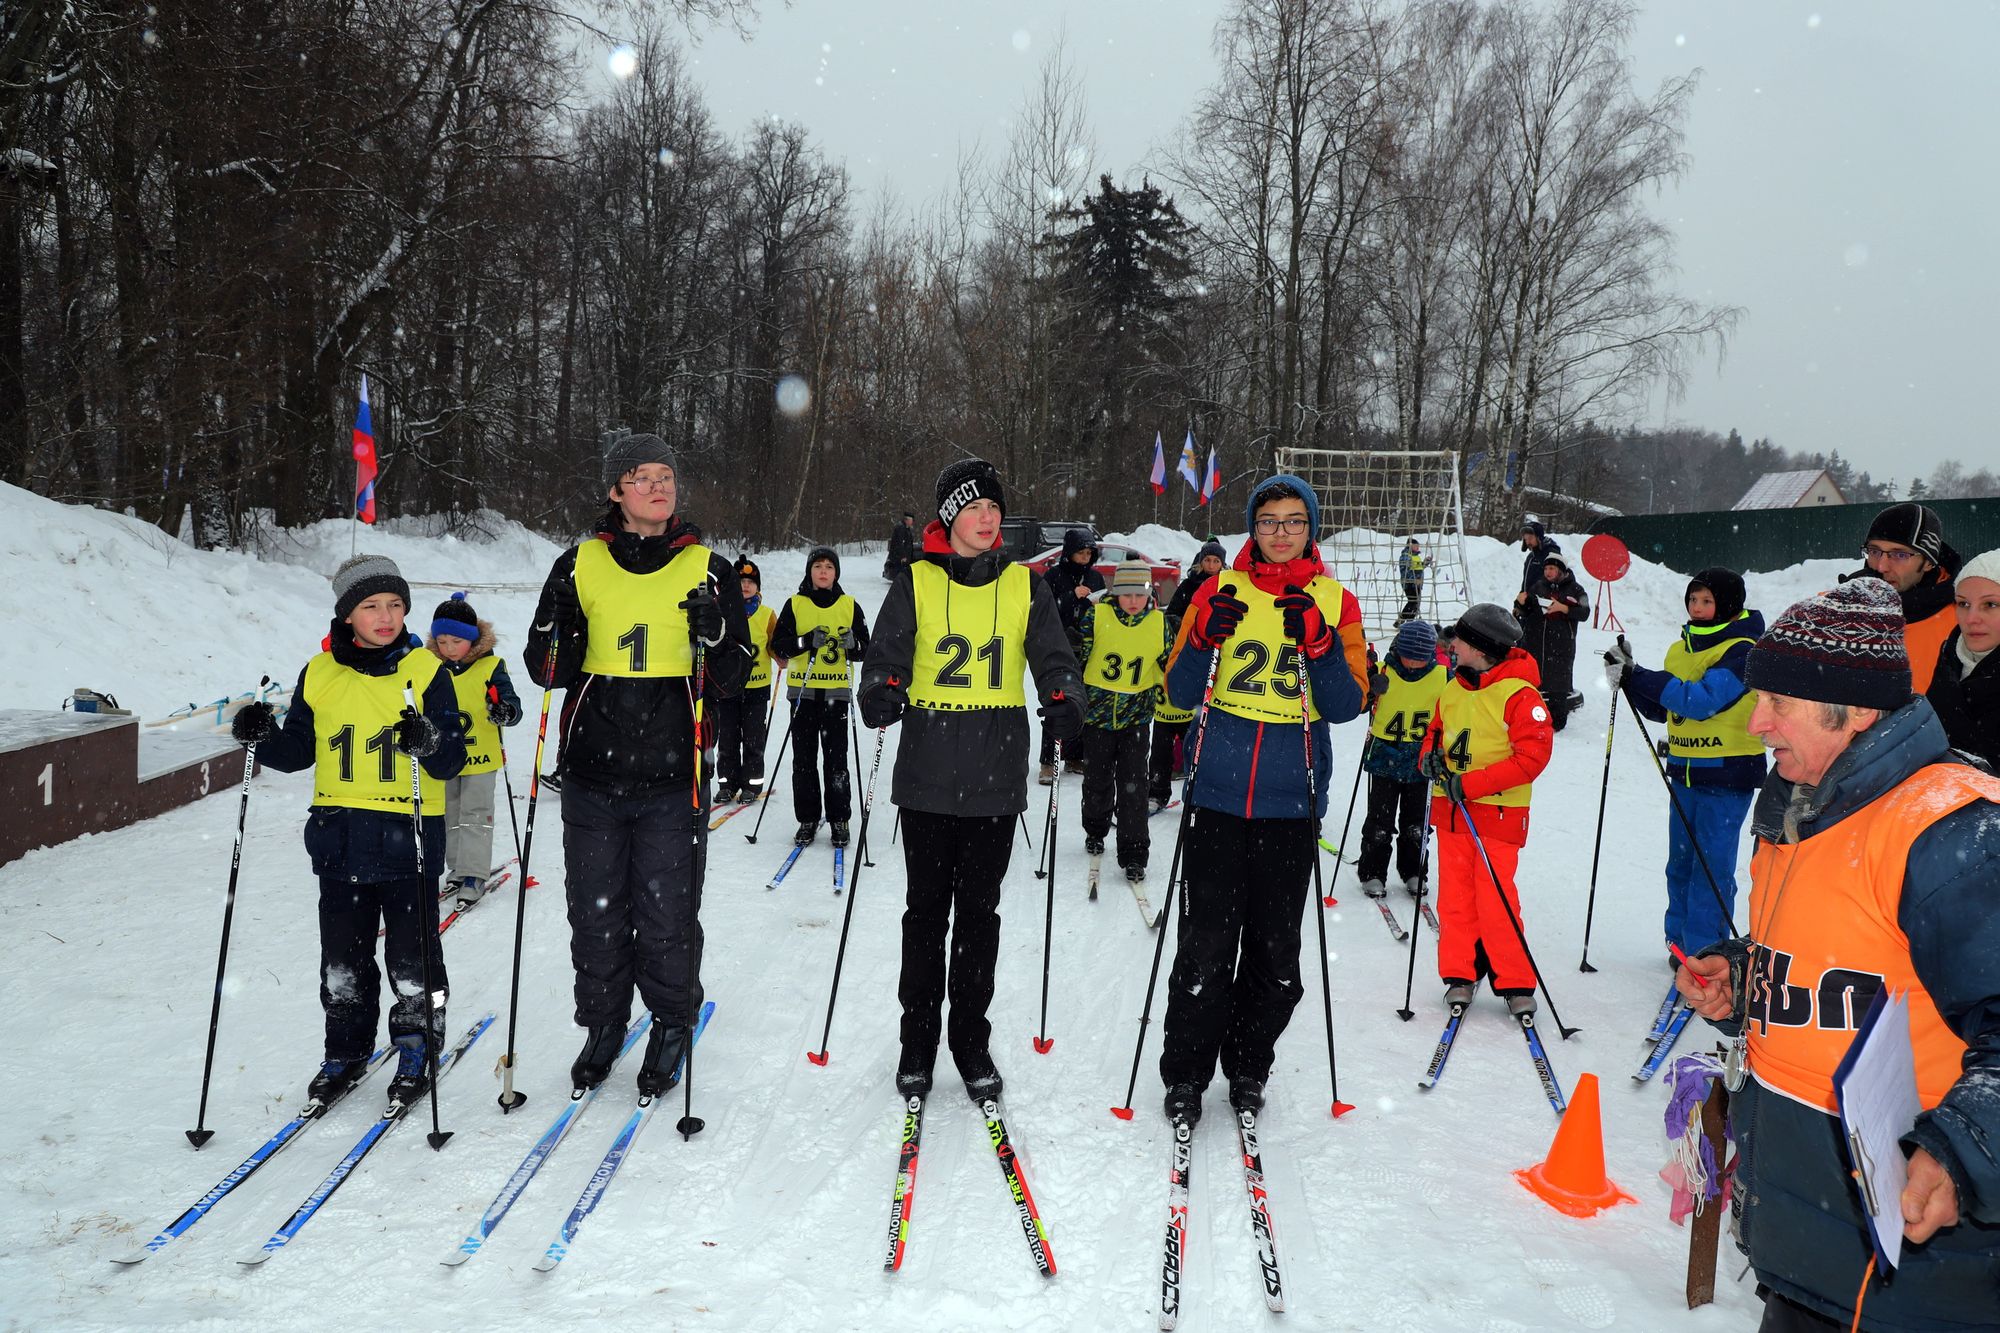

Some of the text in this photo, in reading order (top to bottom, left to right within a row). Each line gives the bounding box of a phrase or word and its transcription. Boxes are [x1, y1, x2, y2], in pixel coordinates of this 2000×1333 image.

[939, 479, 980, 527] PERFECT
[617, 623, 648, 672] 1
[821, 636, 840, 665] 3
[934, 633, 1004, 690] 21
[1101, 652, 1144, 687] 31
[1227, 639, 1301, 700] 25
[1384, 710, 1430, 742] 45
[328, 724, 396, 782] 11
[1448, 728, 1472, 771] 4
[37, 763, 53, 806] 1
[200, 761, 210, 796] 3
[243, 754, 254, 793] NORDWAY
[193, 1158, 260, 1213] NORDWAY
[1007, 1173, 1025, 1202] SABLE
